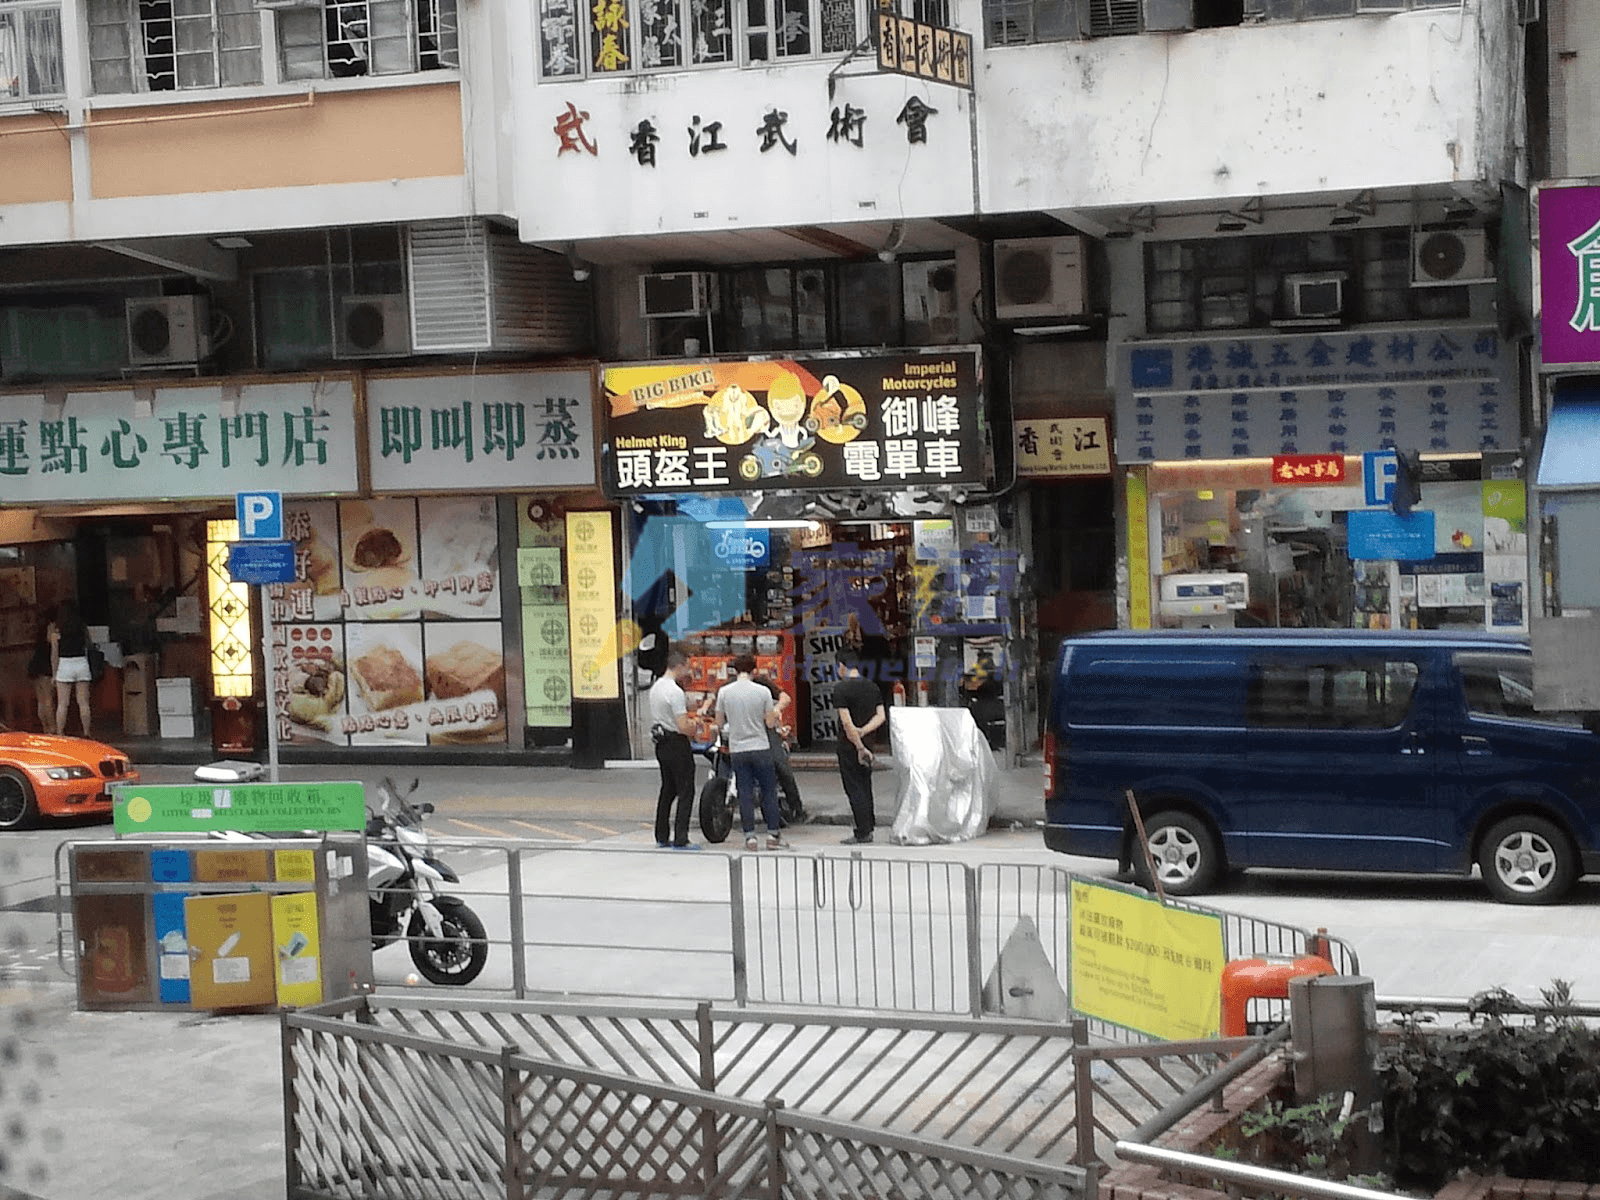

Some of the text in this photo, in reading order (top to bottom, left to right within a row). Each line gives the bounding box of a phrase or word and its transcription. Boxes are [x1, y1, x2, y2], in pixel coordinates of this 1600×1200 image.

[882, 18, 968, 80] 香江武術會
[628, 94, 939, 168] 香江武術會
[633, 369, 714, 402] BIG BIKE
[882, 375, 957, 392] Motorcycles
[904, 360, 957, 377] Imperial
[378, 397, 581, 464] 即叫即蒸
[880, 394, 961, 437] 御峰
[615, 434, 687, 449] Helmet King
[843, 437, 963, 481] 電單車
[616, 446, 730, 489] 頭盔王
[243, 495, 273, 535] P
